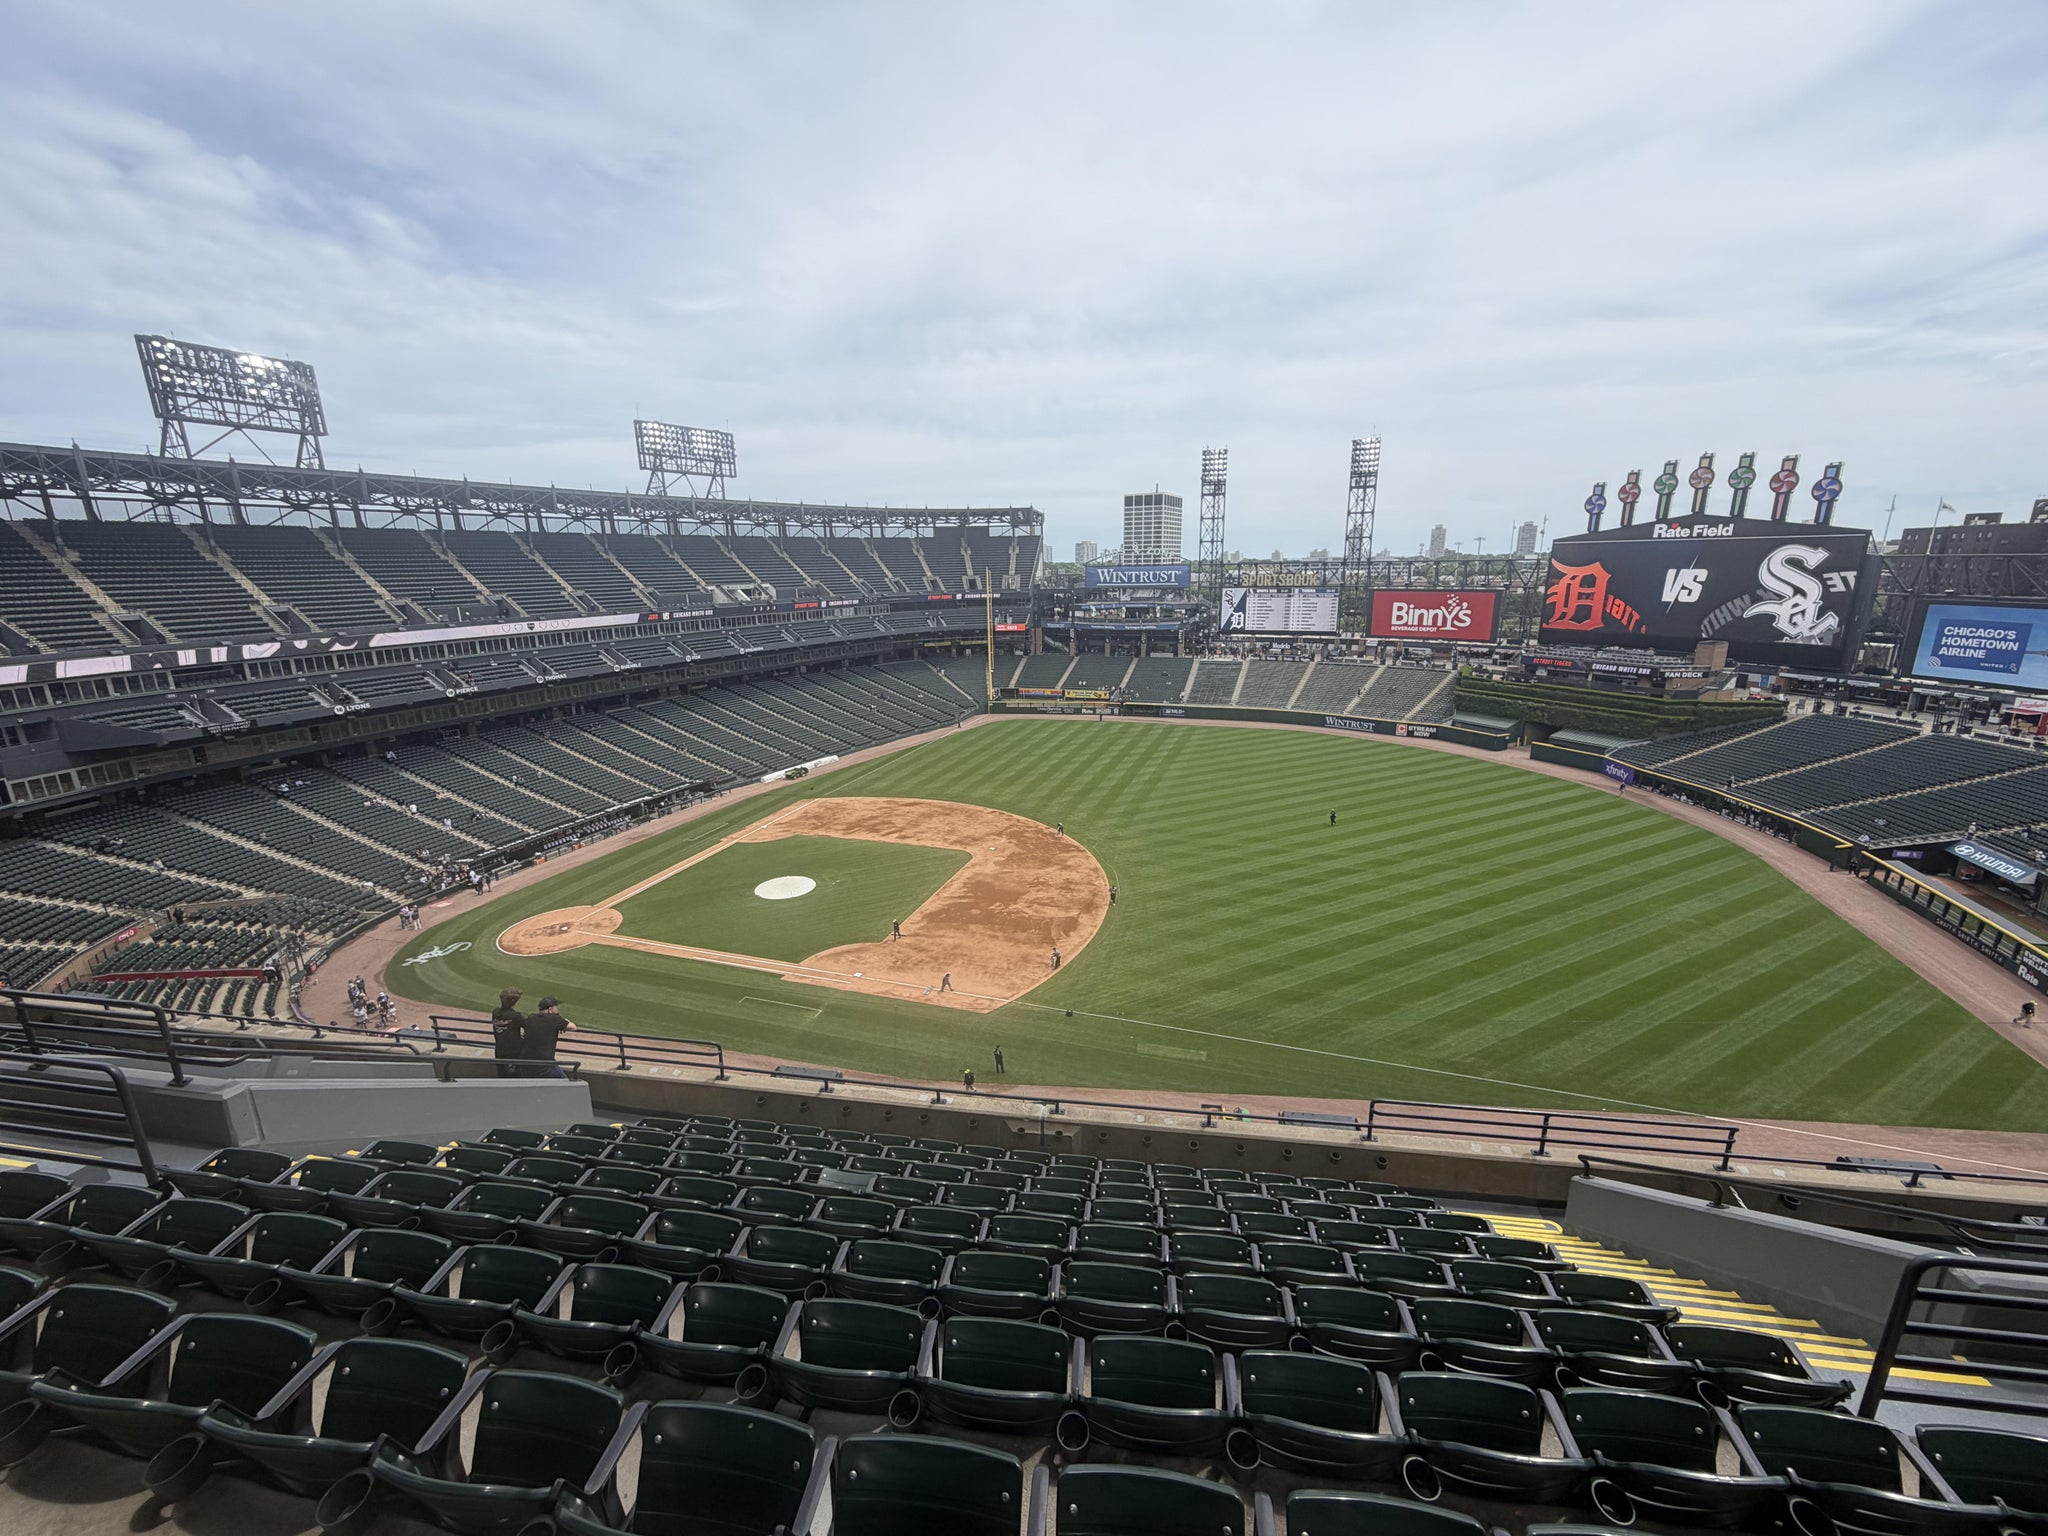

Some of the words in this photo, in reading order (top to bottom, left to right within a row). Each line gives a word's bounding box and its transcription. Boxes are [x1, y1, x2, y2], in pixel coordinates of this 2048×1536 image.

[1653, 523, 1691, 538] Rate
[1692, 523, 1734, 537] Field
[1097, 568, 1181, 583] WINTRUST
[1241, 574, 1318, 587] SPORTSBOOK
[1661, 568, 1708, 603] VS
[1944, 626, 2017, 640] CHICAGO'S
[1941, 637, 2019, 651] HOMETOWN
[1938, 647, 1987, 659] AIRLINE
[1592, 663, 1617, 672] CHICAGO
[1618, 666, 1637, 674] WHITE
[545, 673, 567, 681] THOMAS
[456, 686, 478, 695] PIERCE
[346, 703, 371, 712] LYONS
[1325, 716, 1375, 730] WINTRUST
[1408, 725, 1437, 733] STREAM
[1605, 764, 1629, 780] xfinity
[1971, 852, 2026, 878] HYUNDAI
[2018, 965, 2039, 986] Rate
